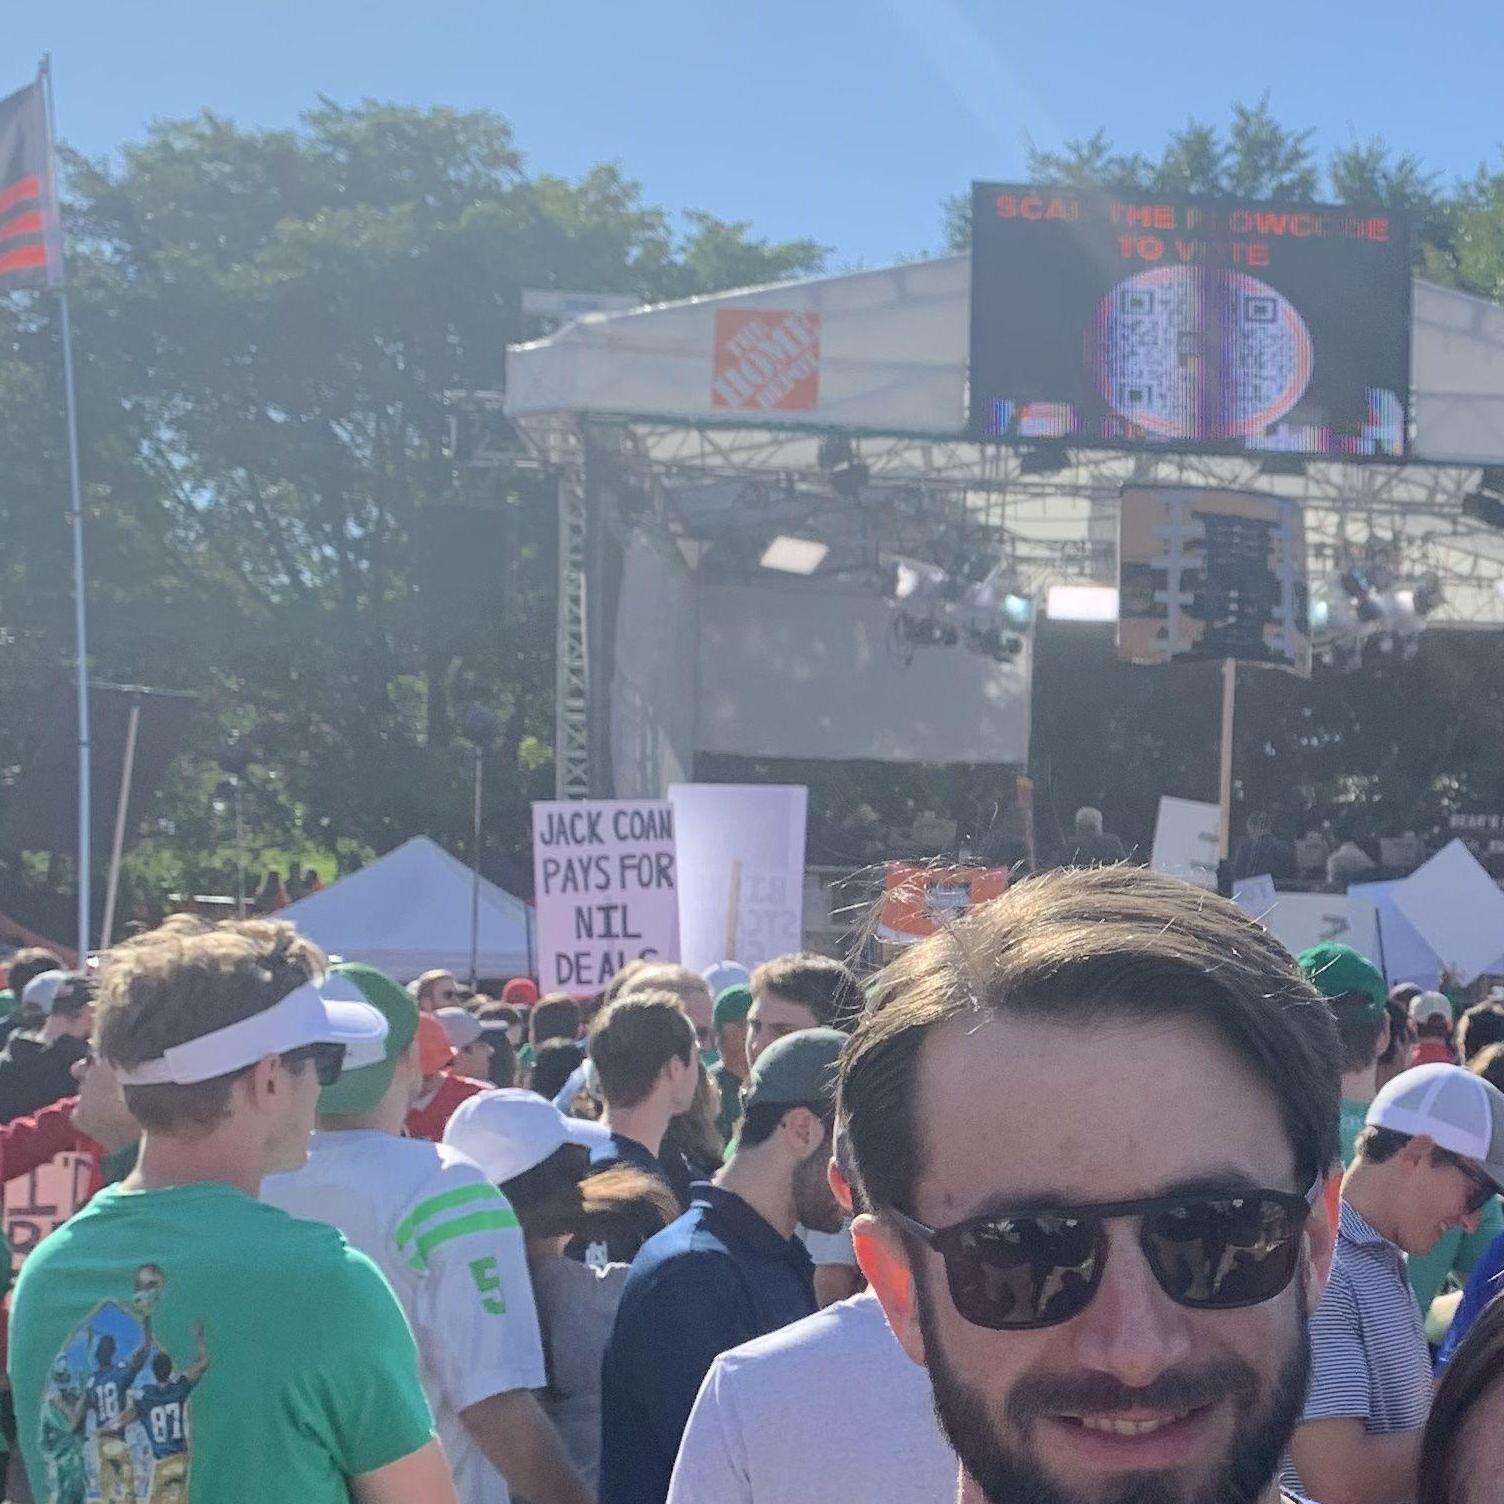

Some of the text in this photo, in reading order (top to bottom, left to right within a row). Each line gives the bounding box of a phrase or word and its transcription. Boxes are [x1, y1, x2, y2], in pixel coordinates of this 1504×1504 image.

[540, 808, 673, 846] JACK COAN
[543, 852, 674, 894] PAYS FOR
[575, 903, 642, 939] NIL
[95, 1382, 119, 1421] 18
[150, 1402, 181, 1443] 87
